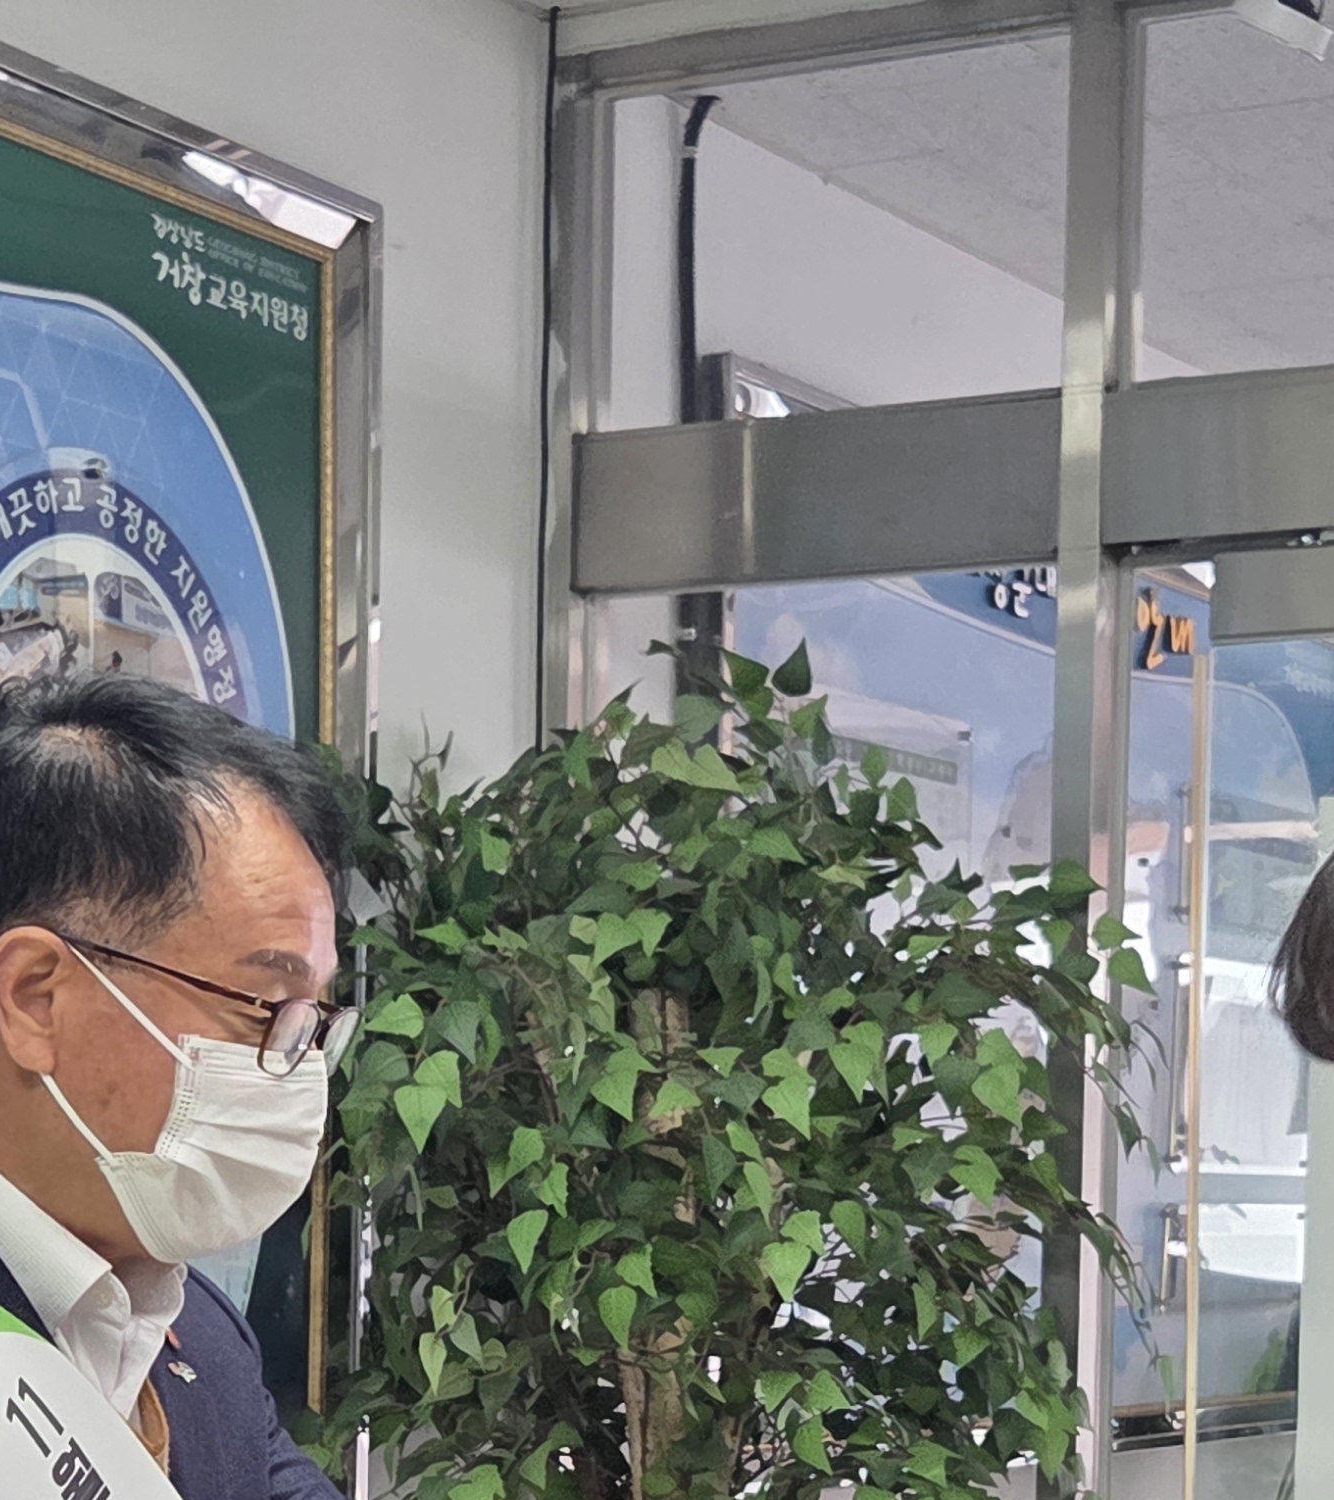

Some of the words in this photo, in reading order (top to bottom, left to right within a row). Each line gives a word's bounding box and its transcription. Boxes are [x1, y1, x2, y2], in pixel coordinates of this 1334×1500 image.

[151, 251, 309, 342] 거창교육지원청
[96, 487, 168, 566] 공정한
[168, 555, 238, 706] 지원행정
